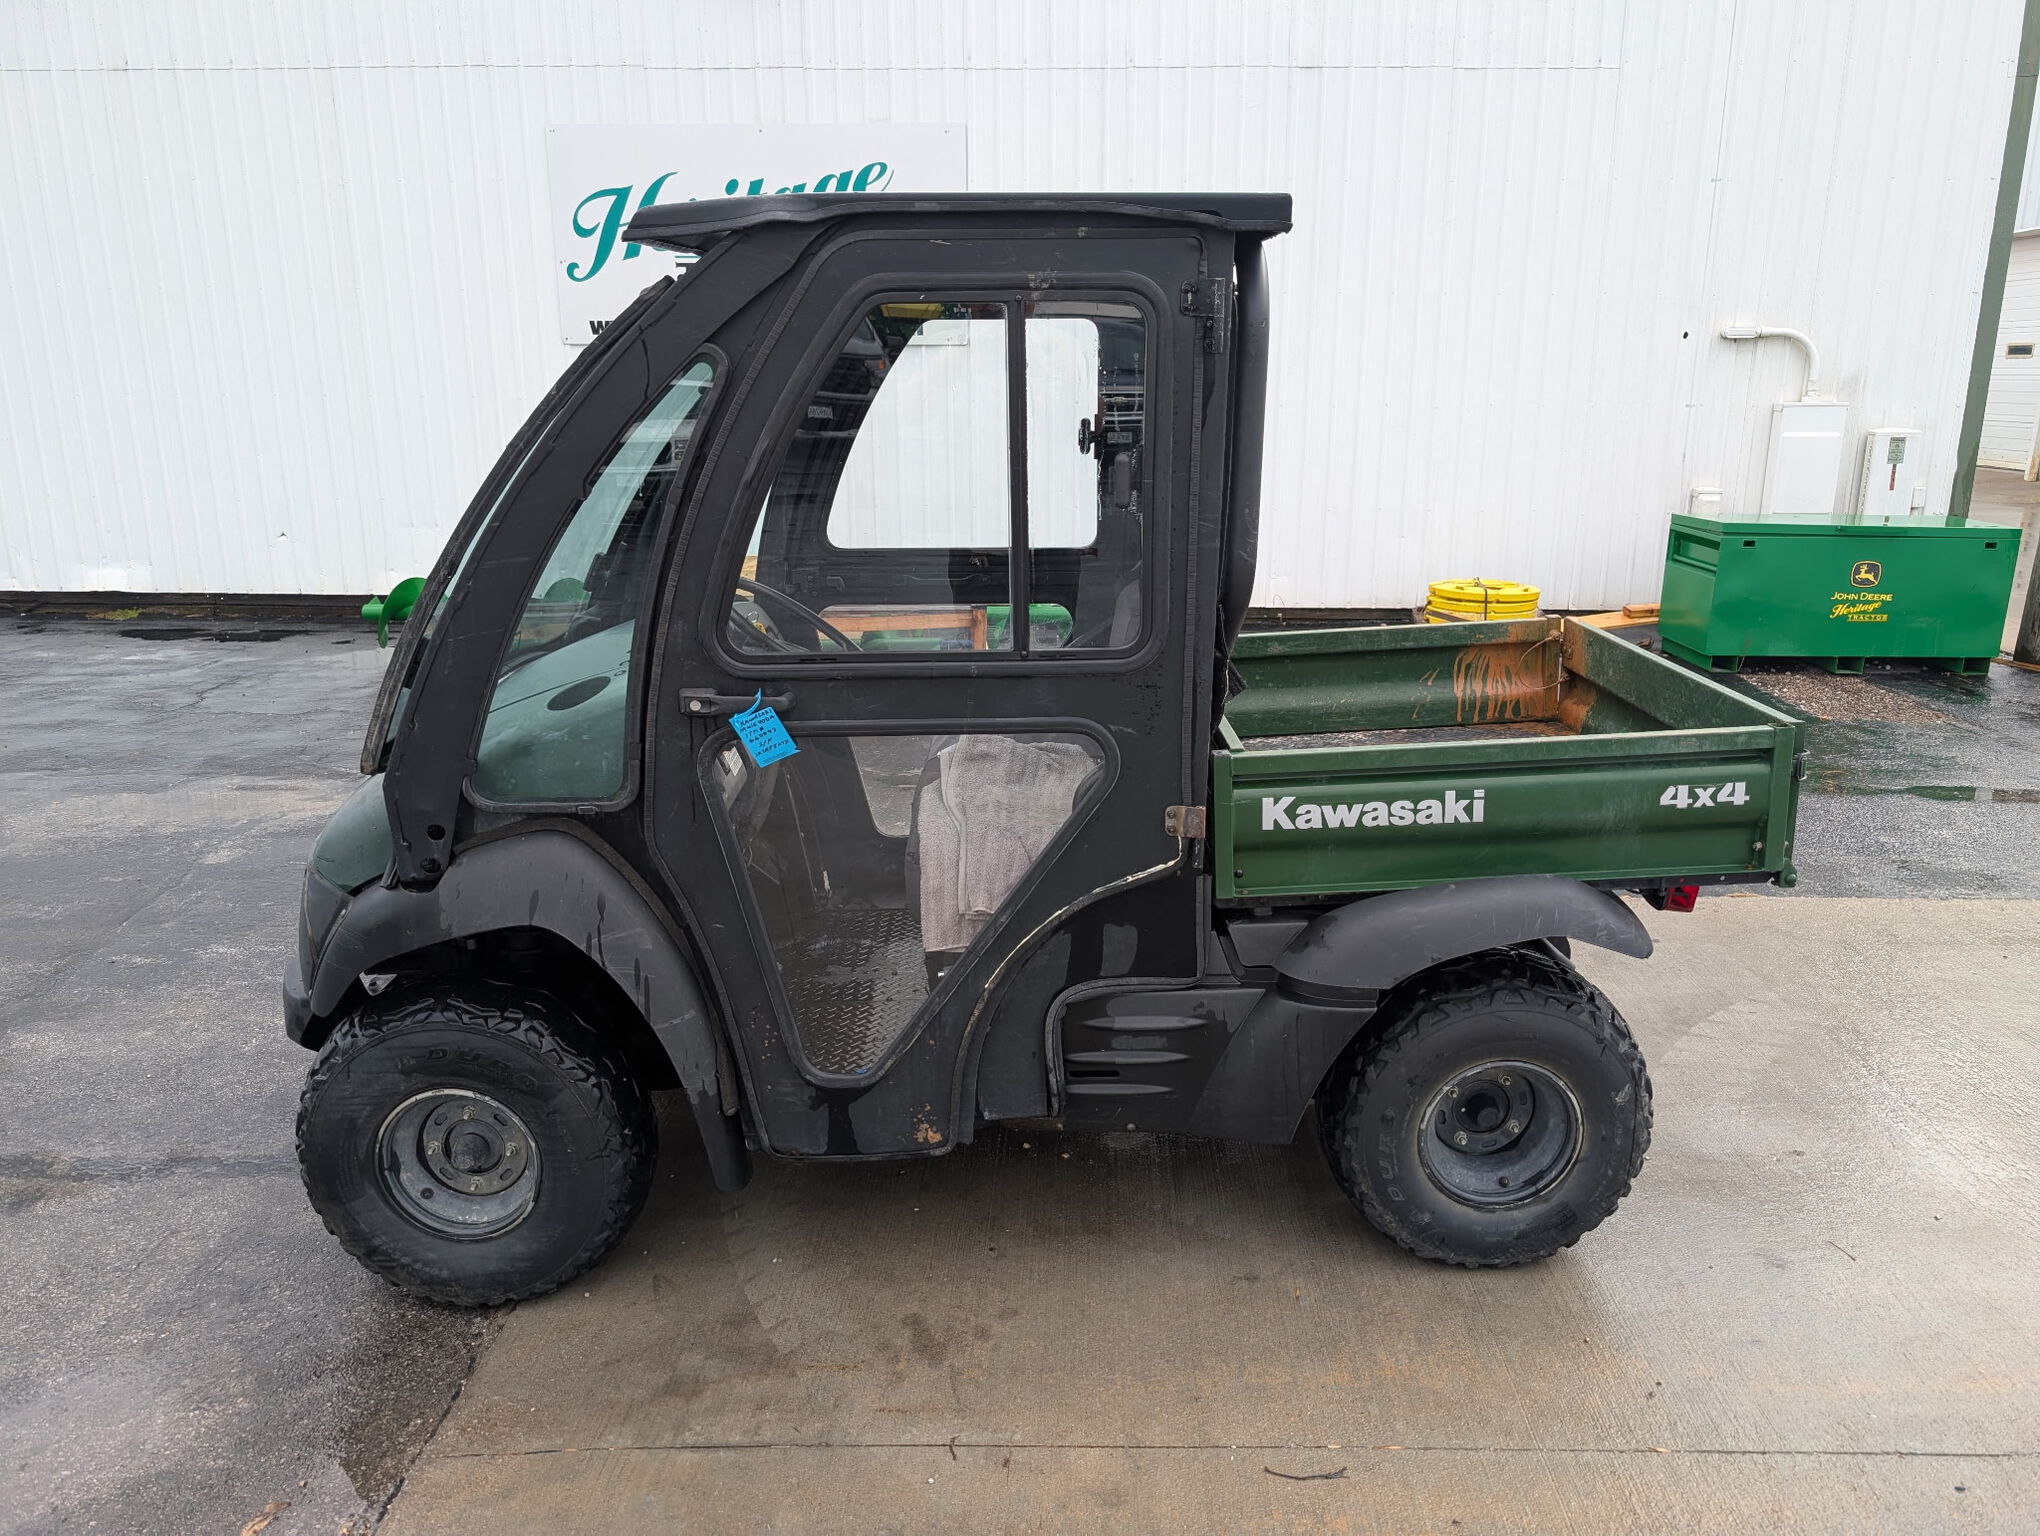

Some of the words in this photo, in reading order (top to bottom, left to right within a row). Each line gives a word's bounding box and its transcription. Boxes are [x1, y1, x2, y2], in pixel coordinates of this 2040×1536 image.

[1830, 592, 1858, 601] JOHN
[1860, 592, 1894, 601] DEERE
[1829, 601, 1882, 619] Heritage
[1660, 782, 1750, 809] 4x4
[1262, 789, 1485, 831] Kawasaki
